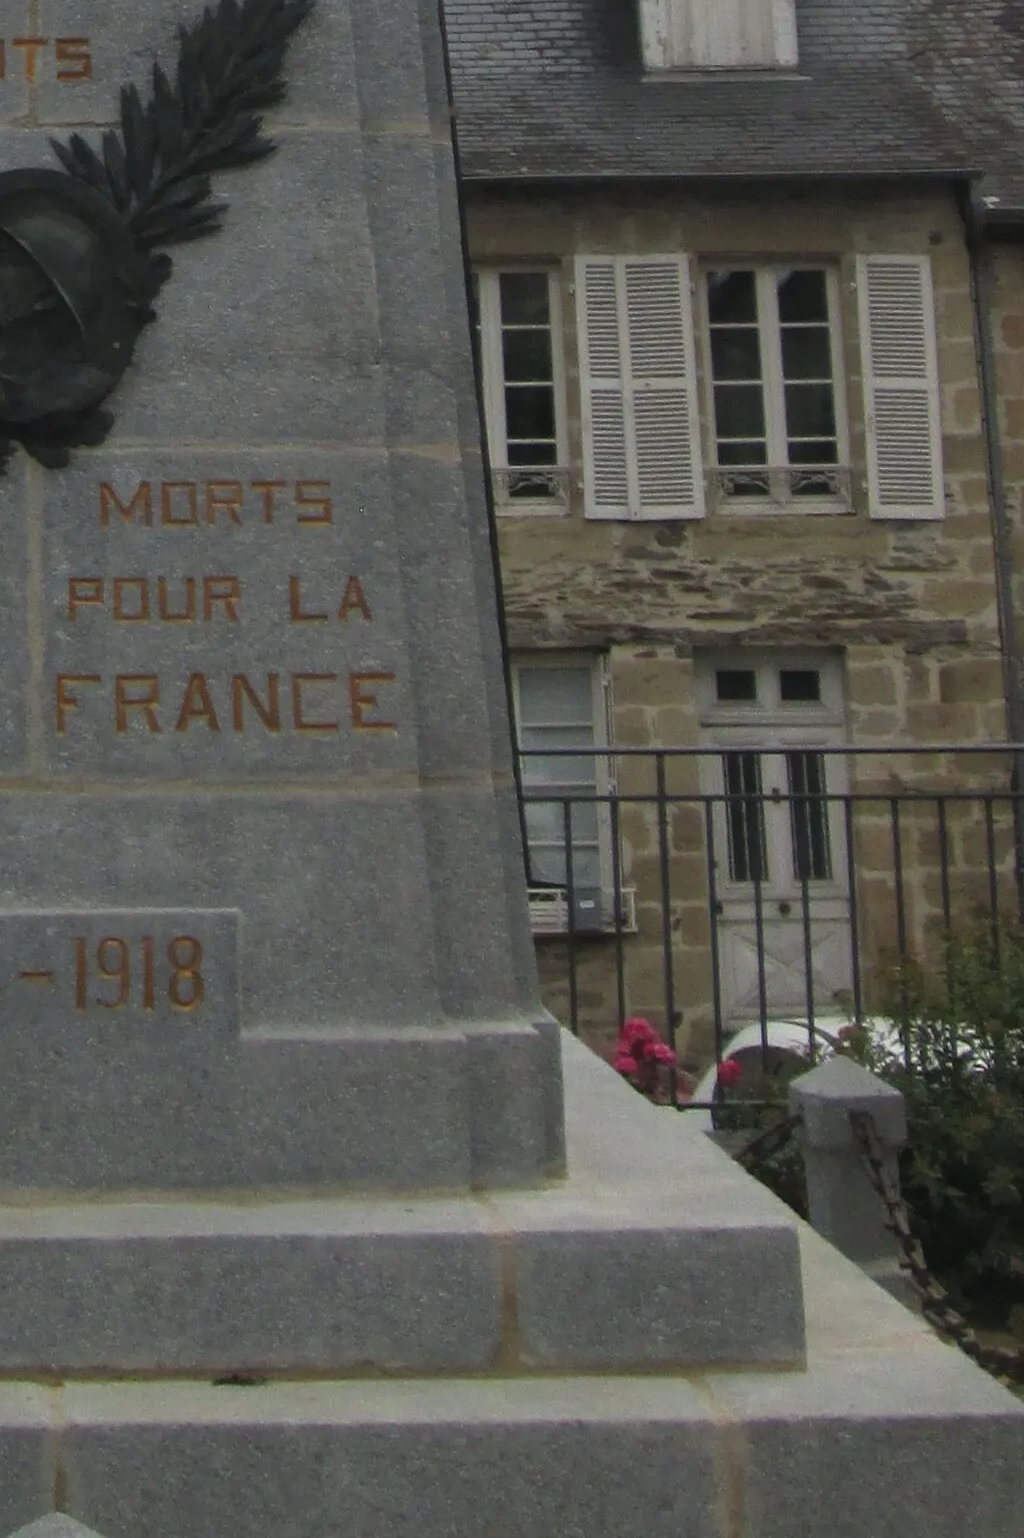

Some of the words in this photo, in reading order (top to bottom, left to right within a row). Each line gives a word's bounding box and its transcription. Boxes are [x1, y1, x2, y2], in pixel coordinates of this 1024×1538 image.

[99, 480, 333, 528] MORTS
[67, 575, 242, 622] POUR
[289, 574, 373, 623] LA
[55, 671, 399, 734] FRANCE
